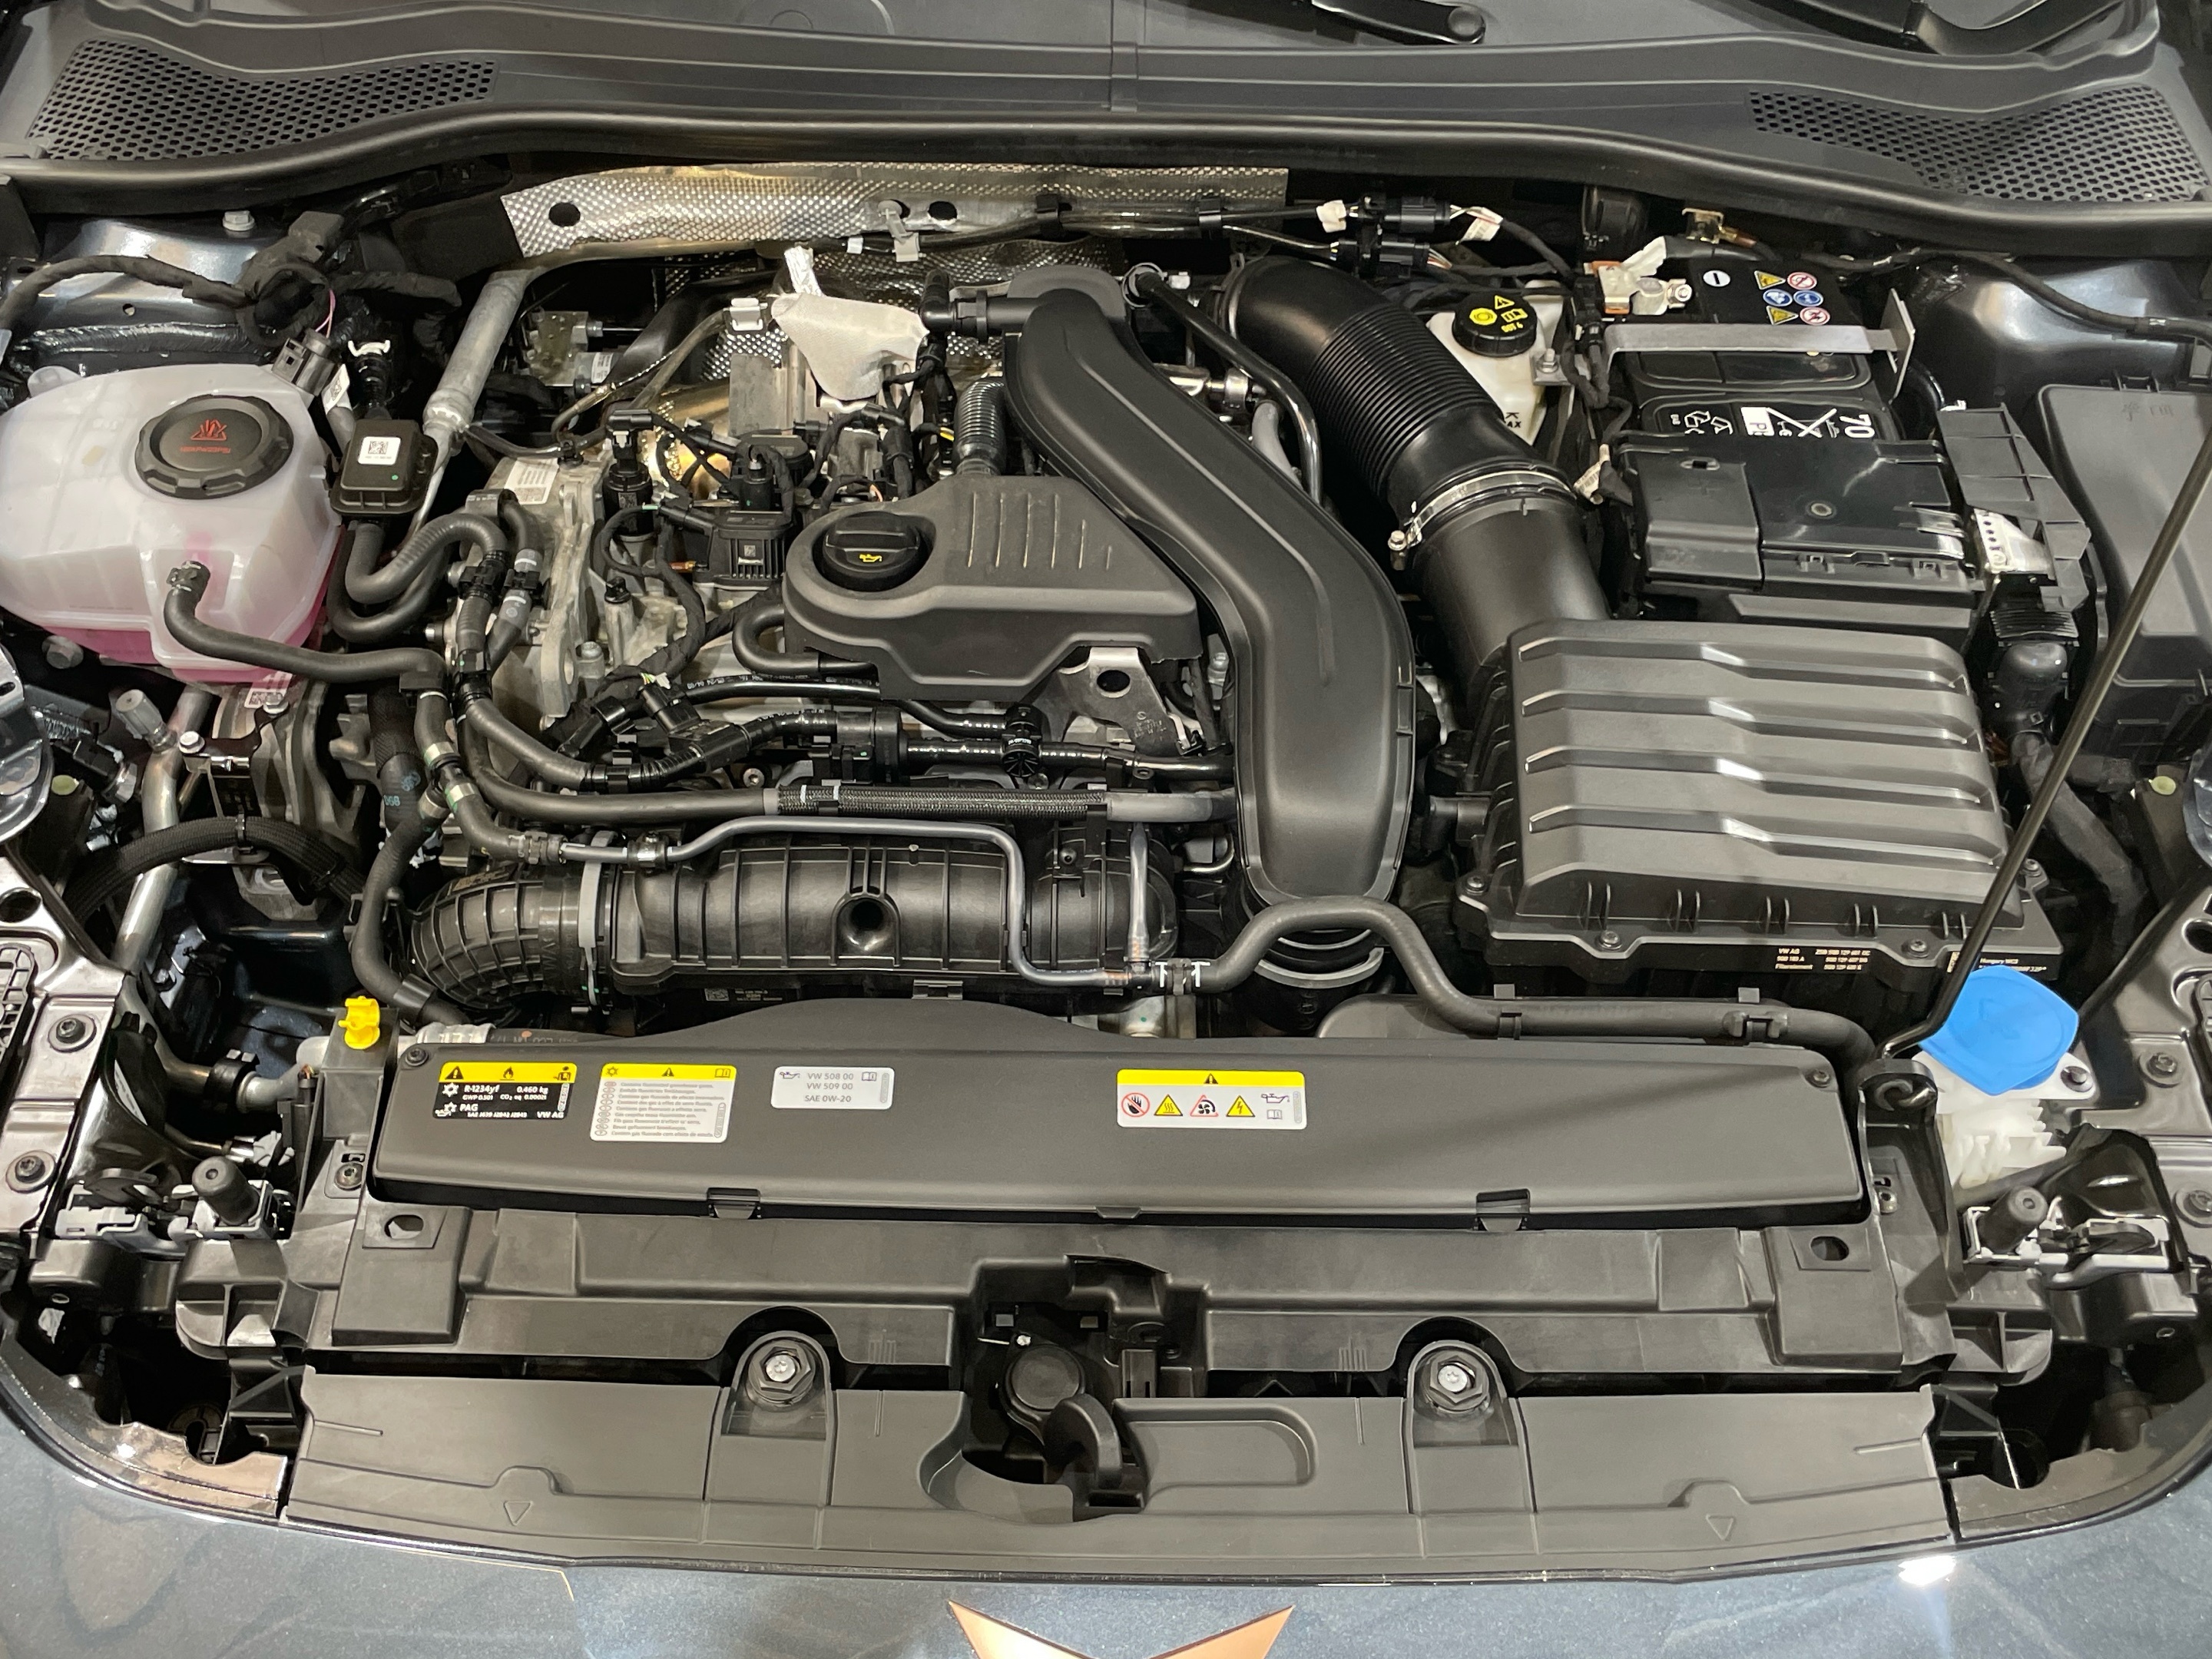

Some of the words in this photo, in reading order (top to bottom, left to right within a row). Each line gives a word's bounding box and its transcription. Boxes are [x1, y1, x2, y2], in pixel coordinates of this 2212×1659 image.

[1839, 414, 1875, 438] 70
[464, 1084, 500, 1094] R-1234yf
[539, 1086, 548, 1094] kg
